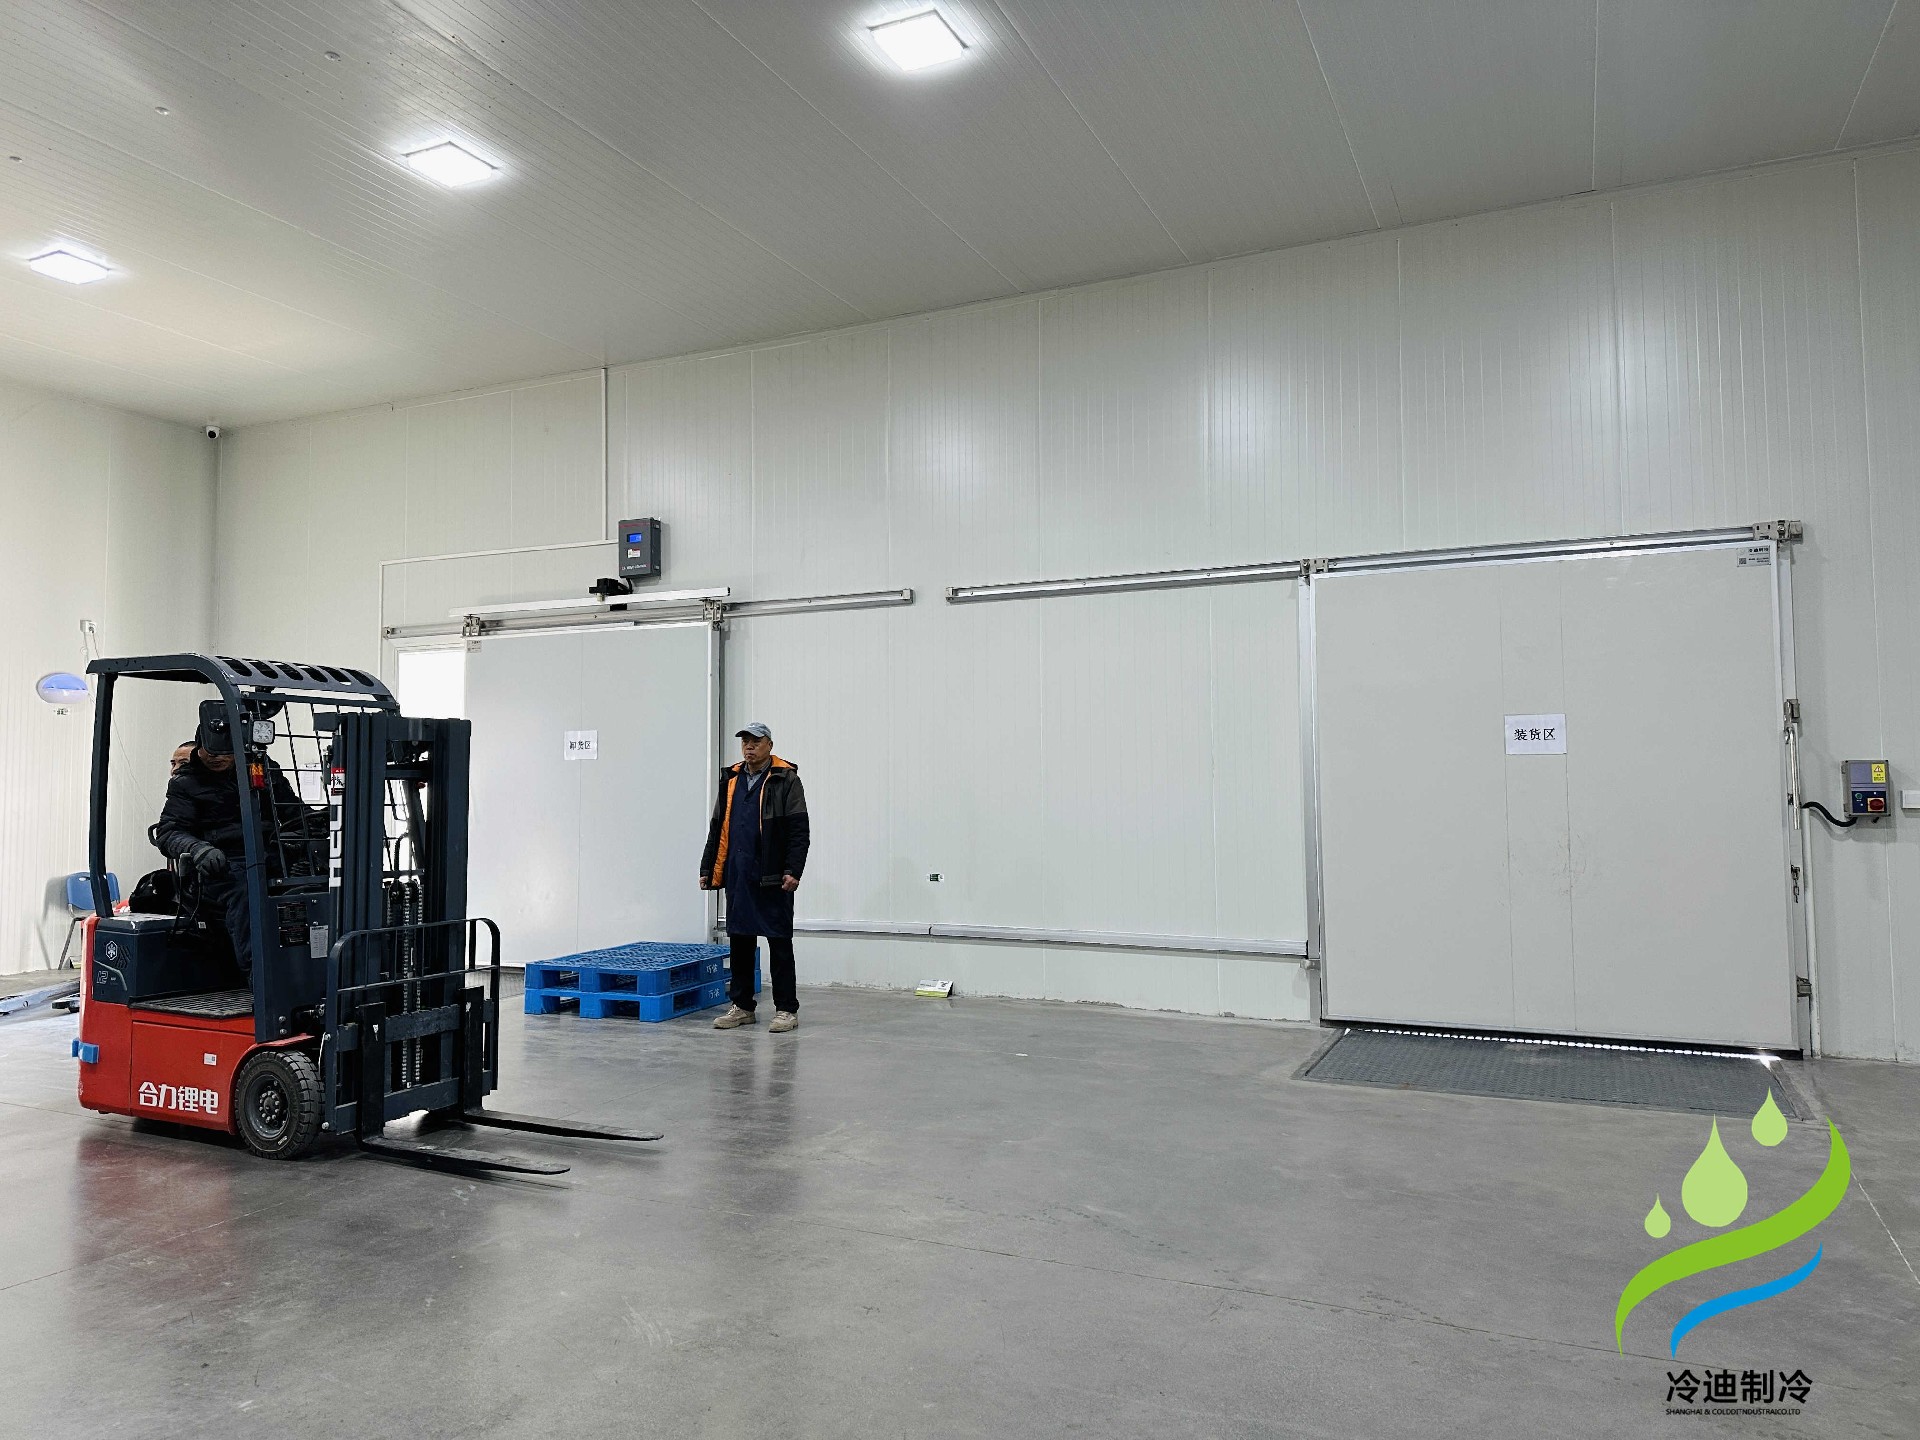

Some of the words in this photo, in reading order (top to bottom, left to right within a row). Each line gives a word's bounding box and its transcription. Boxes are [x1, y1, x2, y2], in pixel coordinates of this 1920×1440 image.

[1513, 727, 1556, 741] 装货区
[138, 1081, 219, 1114] 合力锂电
